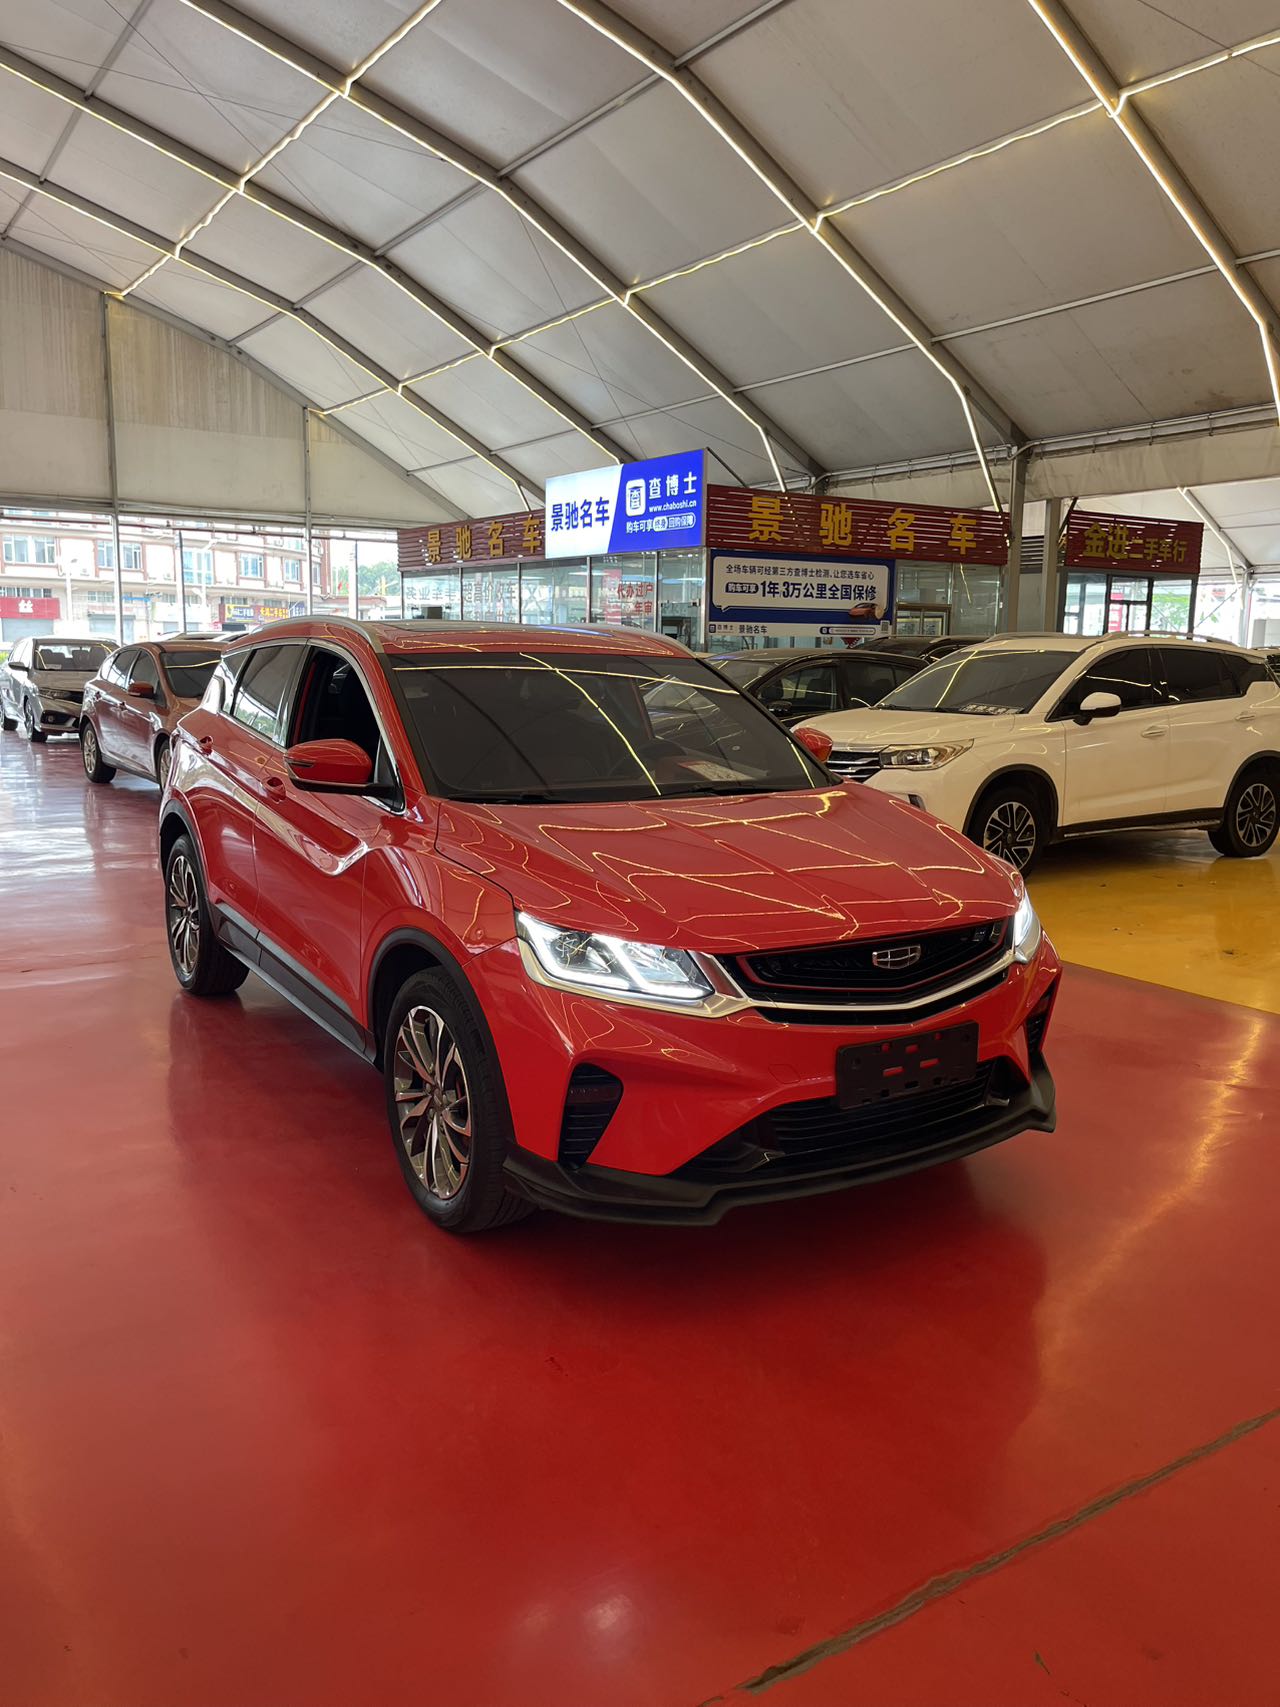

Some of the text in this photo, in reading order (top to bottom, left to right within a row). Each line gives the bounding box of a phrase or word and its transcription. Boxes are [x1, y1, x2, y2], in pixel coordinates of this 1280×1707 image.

[649, 471, 698, 499] 查博士
[551, 496, 610, 532] 景驰名车
[648, 499, 697, 513] www.chaboshi.cn
[747, 496, 977, 555] 景驰名车
[427, 514, 542, 563] 景驰名车
[616, 582, 654, 600] 代办过户
[634, 600, 653, 615] 年审
[738, 624, 768, 634] 景驰名车
